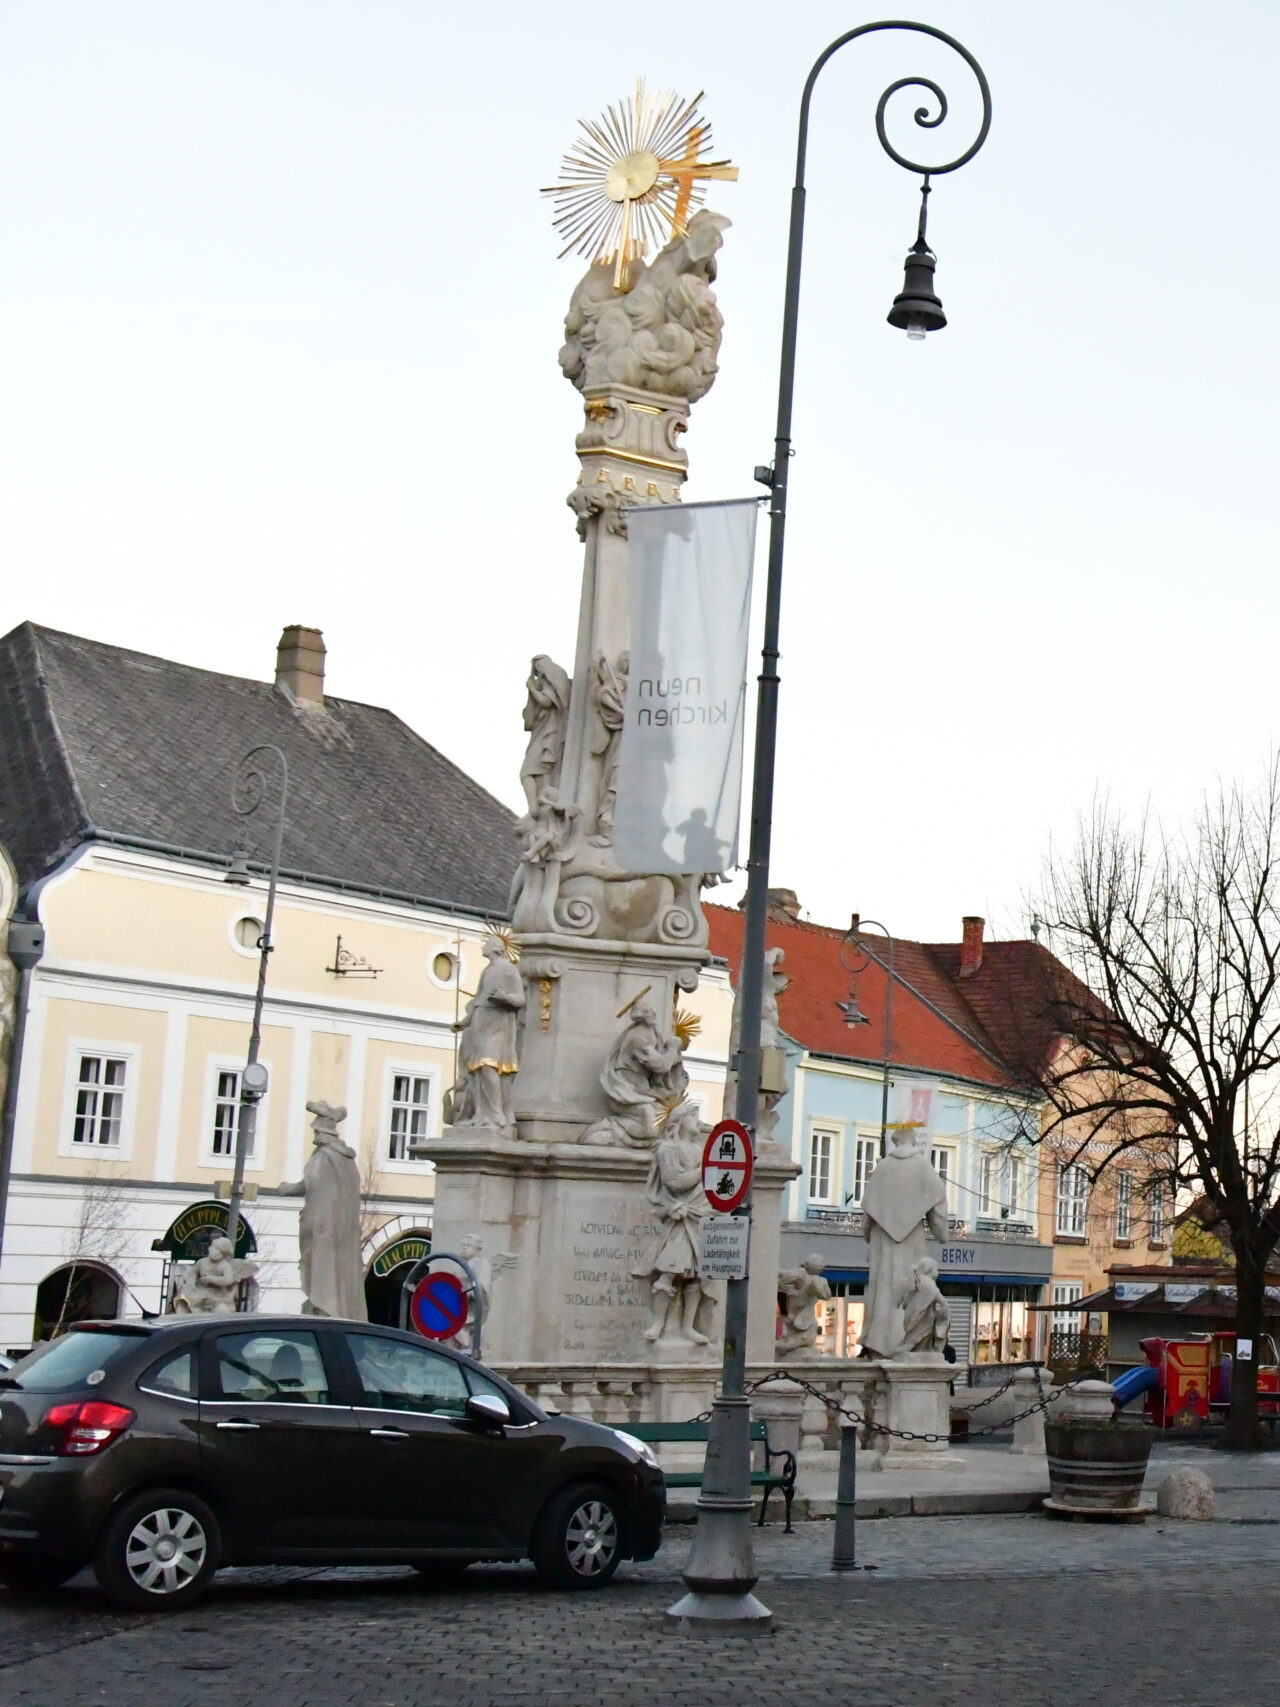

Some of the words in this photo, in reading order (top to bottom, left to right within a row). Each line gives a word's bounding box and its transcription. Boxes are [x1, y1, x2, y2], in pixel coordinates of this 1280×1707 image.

[702, 1222, 746, 1234] ausgenommen
[706, 1234, 727, 1245] Zufahrt
[729, 1236, 738, 1245] zur
[703, 1248, 740, 1261] Ladetätigkeit
[942, 1248, 975, 1264] BERKY
[701, 1264, 710, 1273] am
[711, 1262, 742, 1276] Hauptplatz
